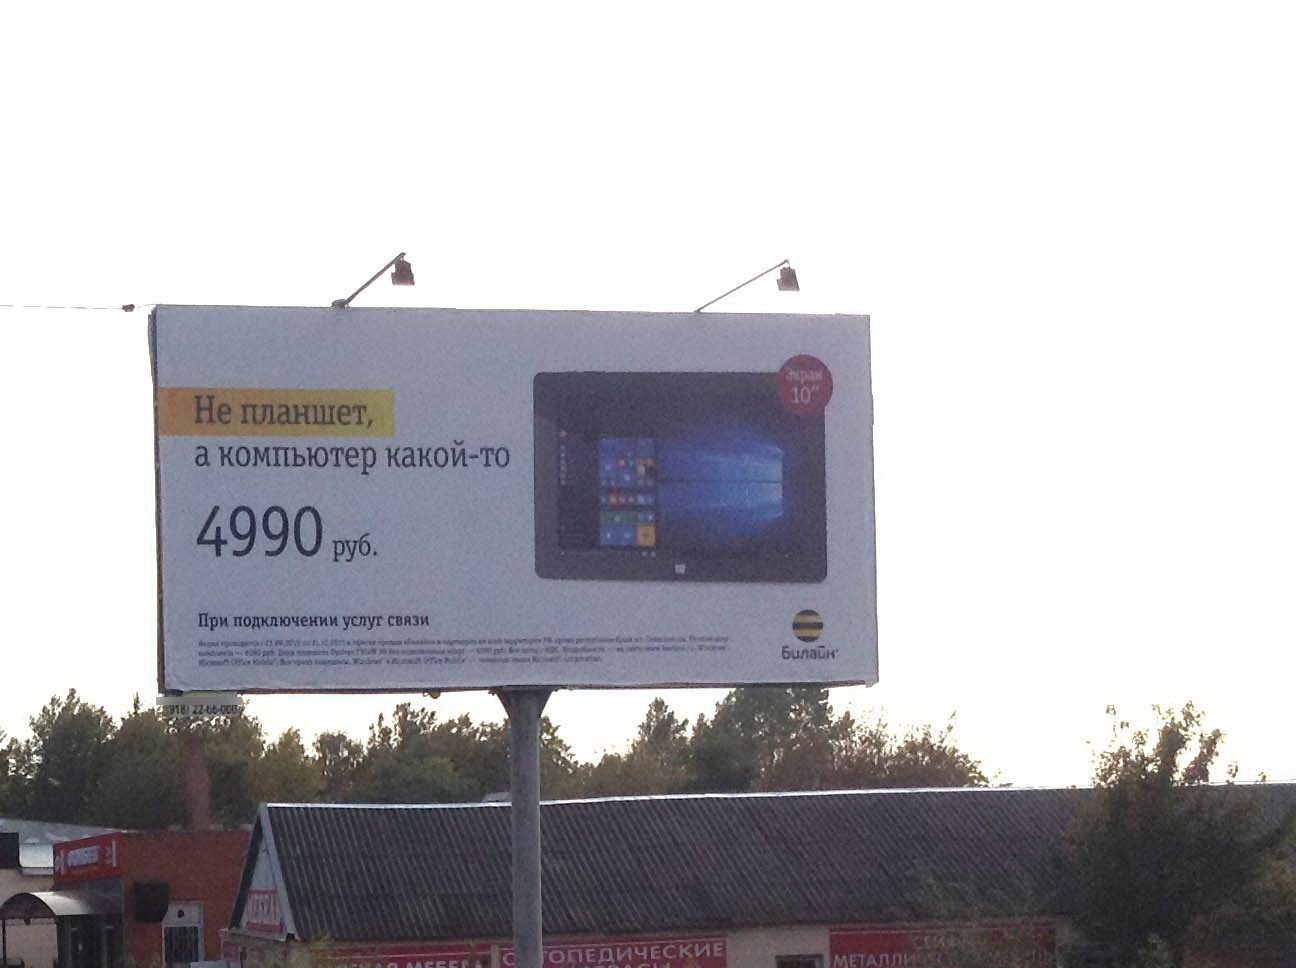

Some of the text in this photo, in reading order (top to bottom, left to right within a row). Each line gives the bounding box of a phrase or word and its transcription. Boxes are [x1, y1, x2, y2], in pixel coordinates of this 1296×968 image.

[193, 395, 375, 429] Не планшет,
[194, 440, 511, 476] а компьютер какой-то
[196, 505, 379, 562] 4990 руб.
[198, 612, 430, 631] При подключении услуг связи
[502, 942, 724, 966] ООПЕДИЧЕСКИЕ
